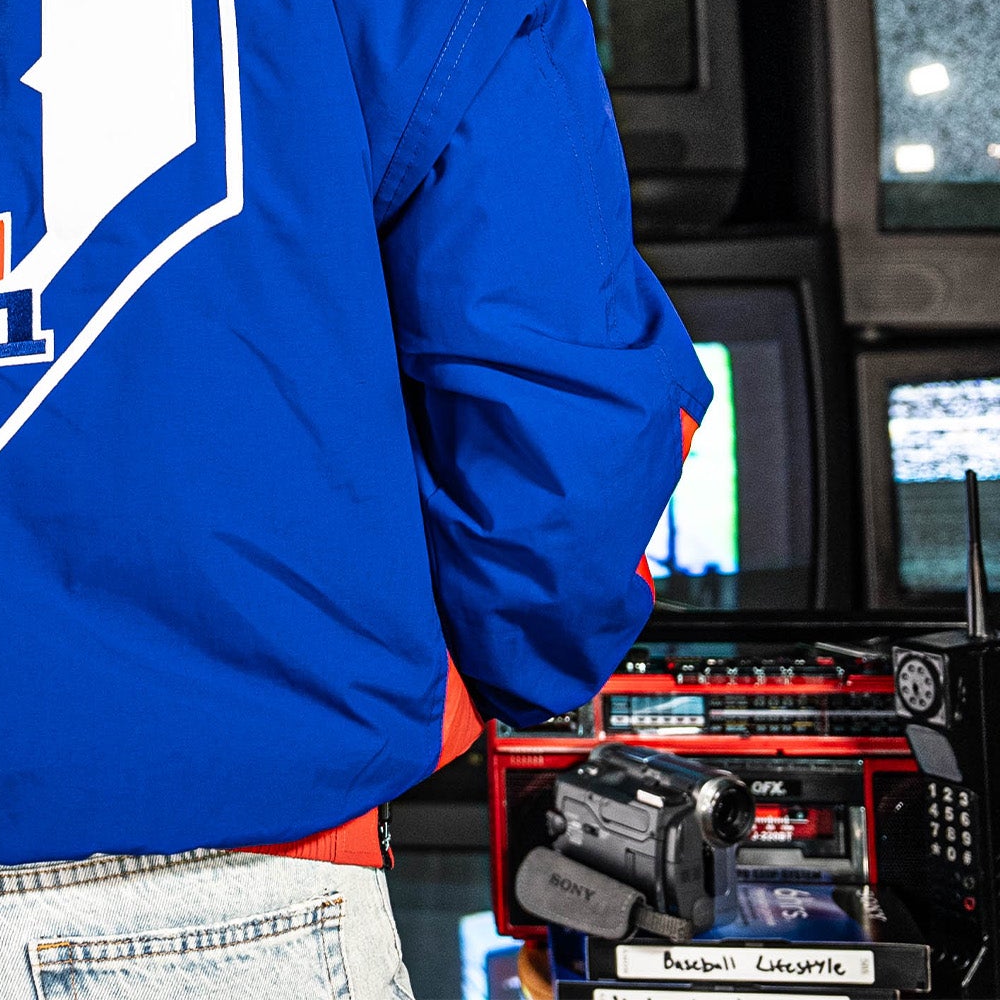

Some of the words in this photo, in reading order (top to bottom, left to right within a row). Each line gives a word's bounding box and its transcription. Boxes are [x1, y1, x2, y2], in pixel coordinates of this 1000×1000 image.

[928, 782, 937, 798] 1
[942, 786, 953, 802] 2
[959, 791, 969, 807] 3
[928, 802, 939, 818] 4
[944, 806, 954, 822] 5
[960, 811, 971, 827] 6
[930, 821, 940, 838] 7
[945, 826, 956, 842] 8
[961, 830, 972, 847] 9
[946, 846, 957, 862] 0
[550, 873, 596, 901] SONY
[663, 950, 736, 973] Baseball
